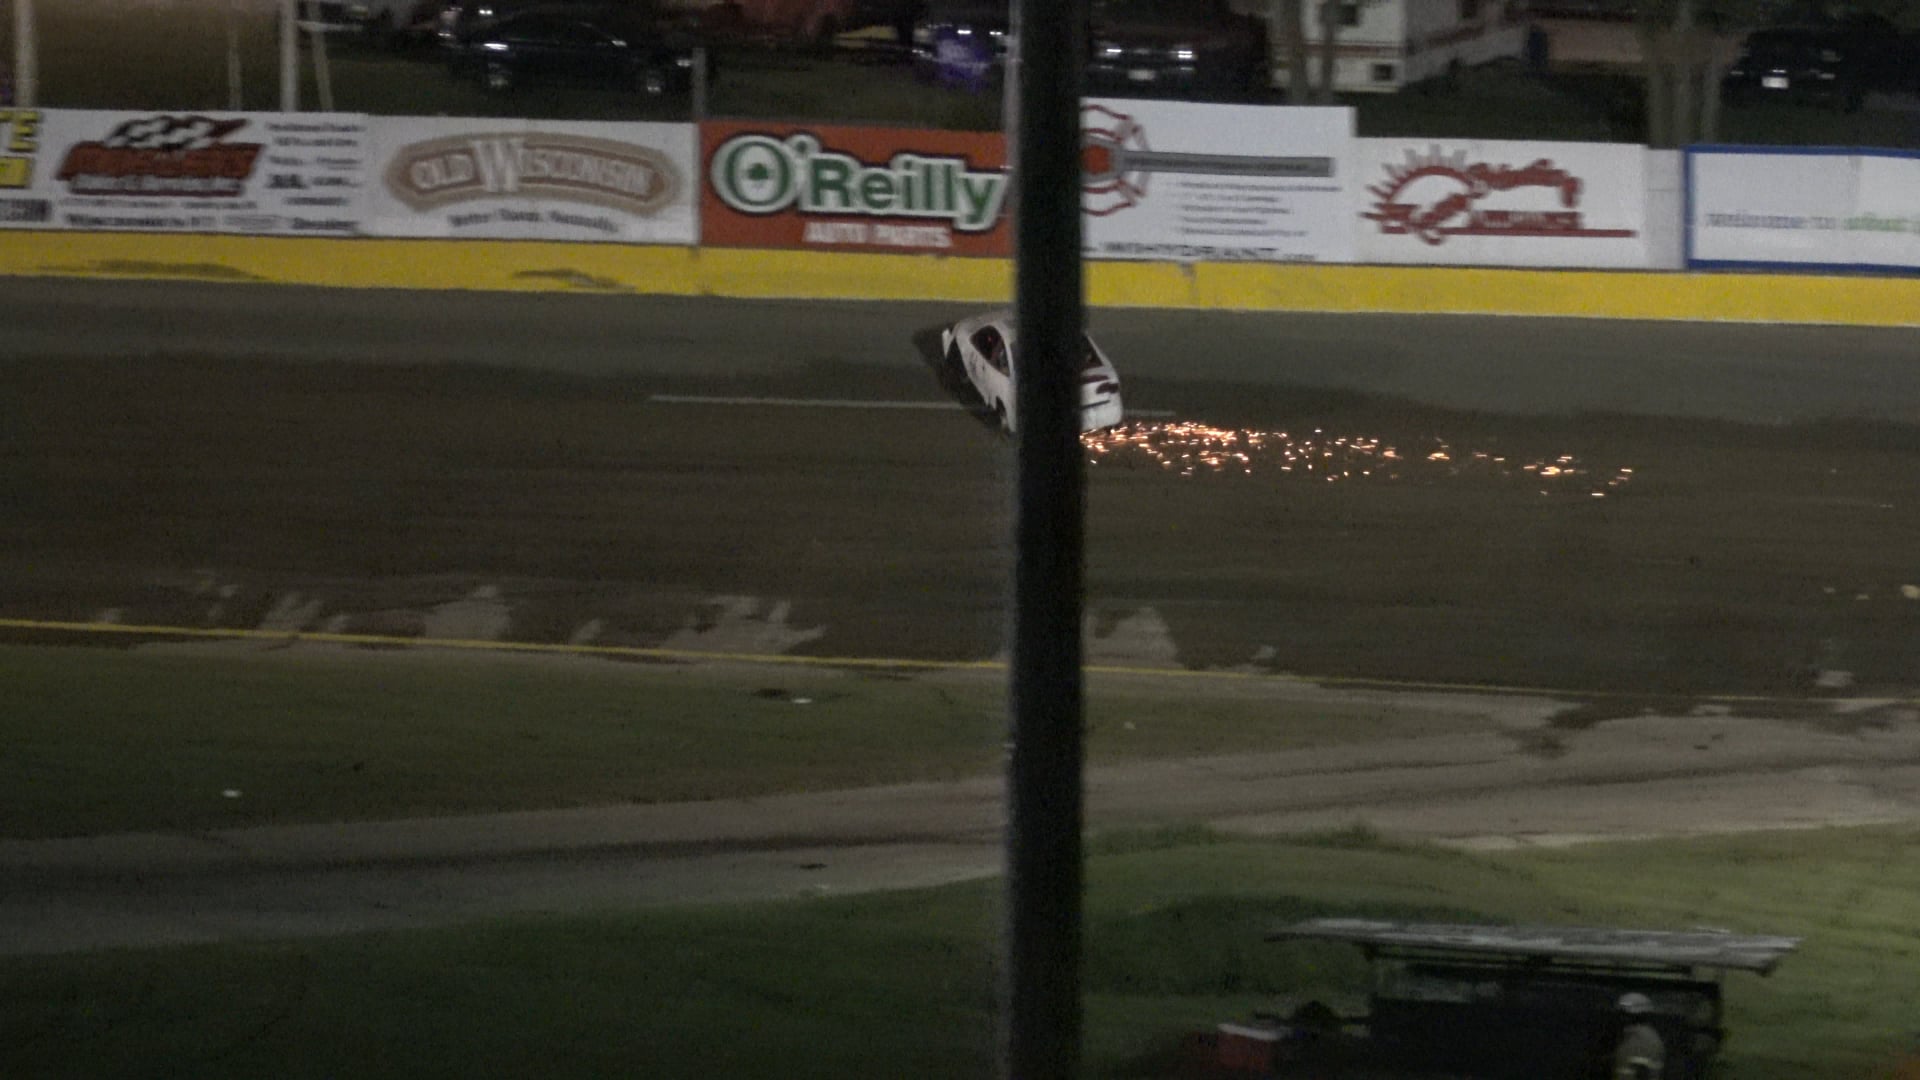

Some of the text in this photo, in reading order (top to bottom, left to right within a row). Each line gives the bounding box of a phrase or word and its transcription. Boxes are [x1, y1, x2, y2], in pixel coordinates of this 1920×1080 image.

[408, 153, 477, 190] OLD
[711, 133, 1008, 231] O'Reilly
[804, 221, 952, 248] AUTO PARTS
